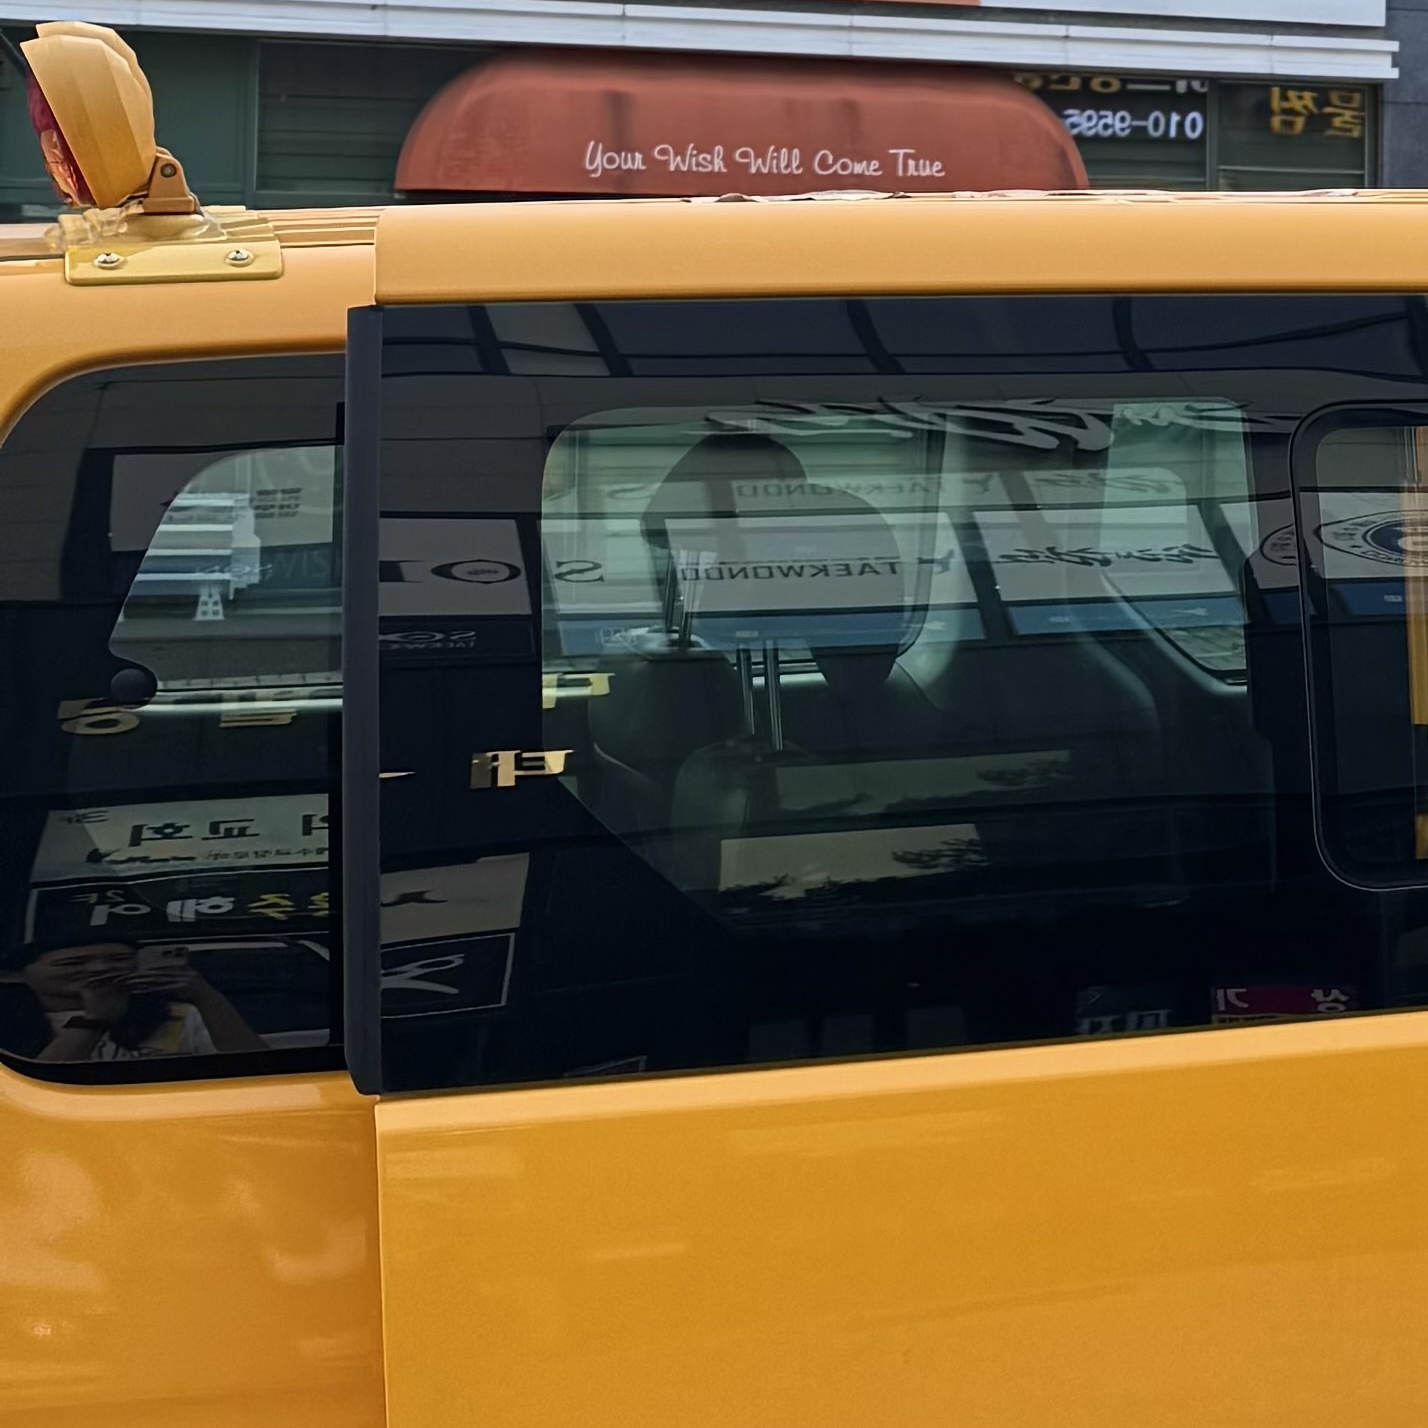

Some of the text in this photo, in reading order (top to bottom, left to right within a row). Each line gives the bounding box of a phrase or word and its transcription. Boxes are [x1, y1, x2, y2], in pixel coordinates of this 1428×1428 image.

[585, 141, 945, 177] Your Wish Will Come True
